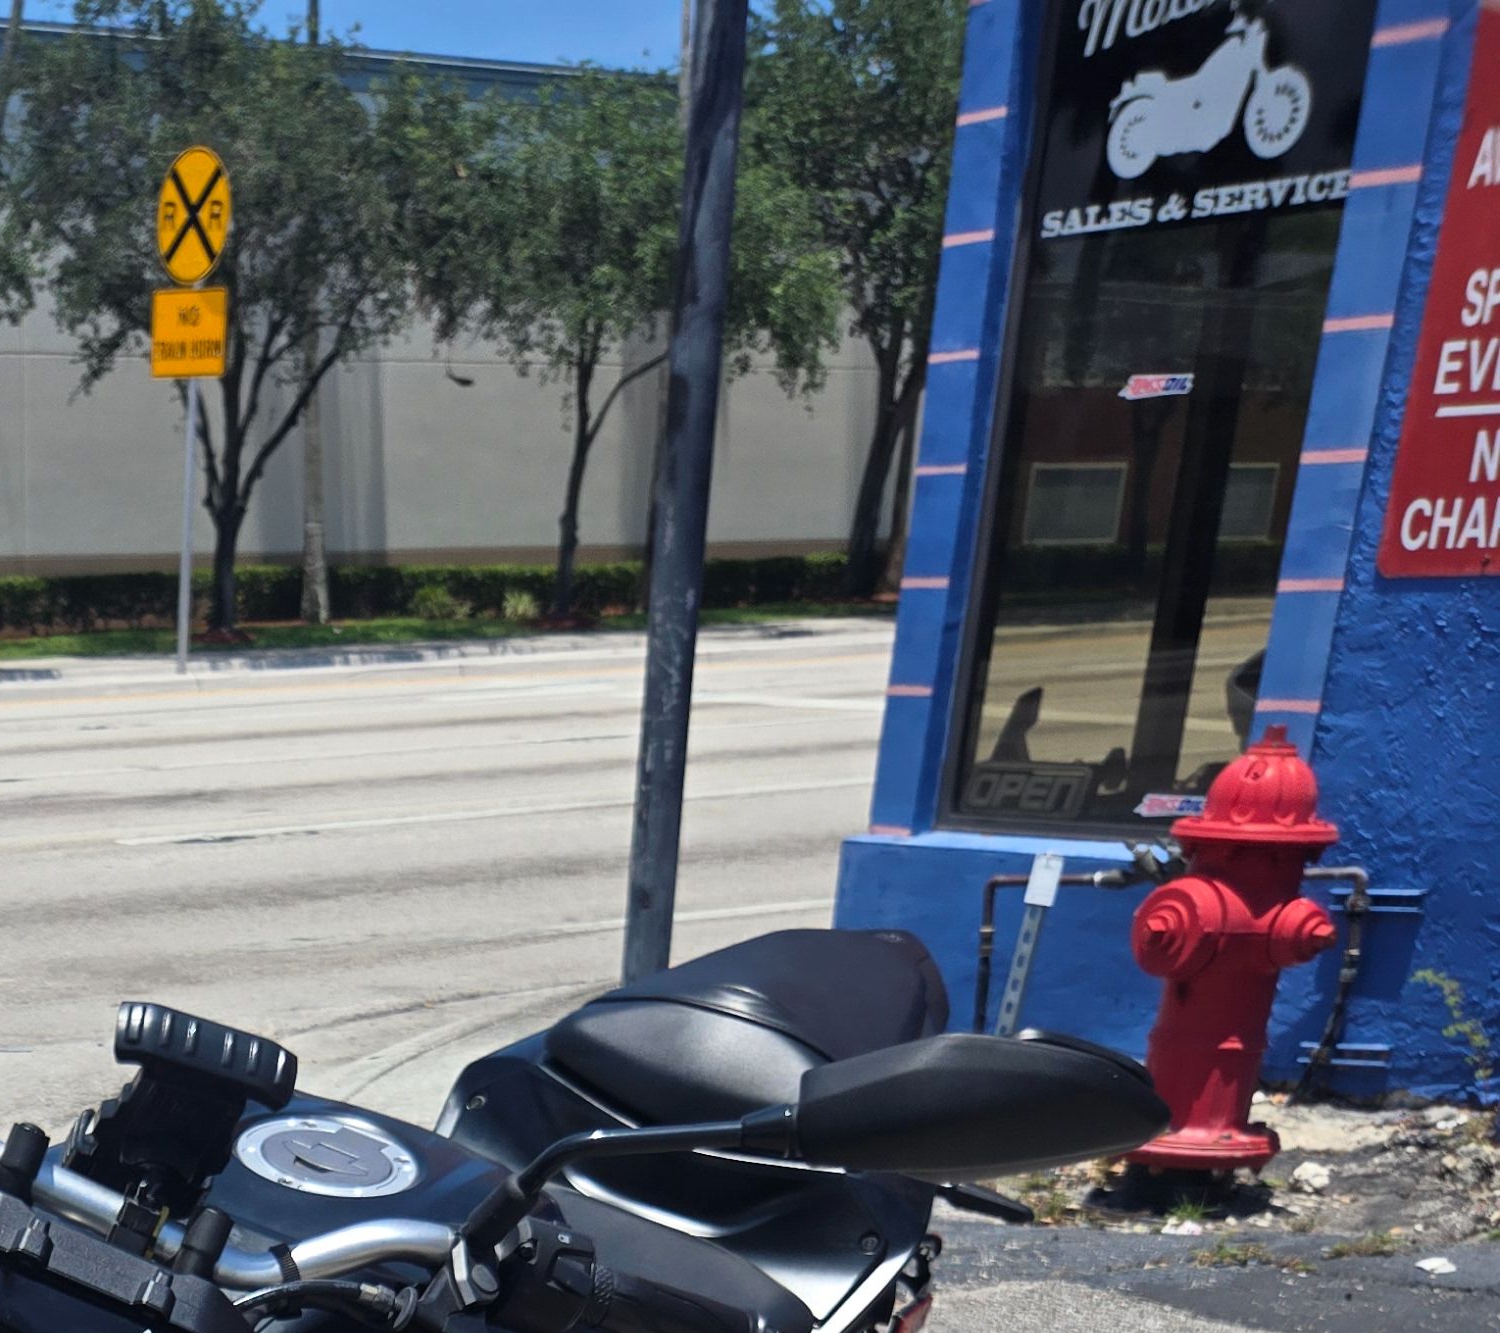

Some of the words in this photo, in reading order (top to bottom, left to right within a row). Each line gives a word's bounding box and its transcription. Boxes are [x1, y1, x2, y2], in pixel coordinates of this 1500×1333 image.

[1466, 125, 1500, 189] A
[1041, 197, 1153, 238] SALES
[1156, 193, 1190, 223] &
[1191, 169, 1353, 218] SERVICE
[1433, 337, 1500, 394] EV
[968, 773, 1077, 814] OPEN
